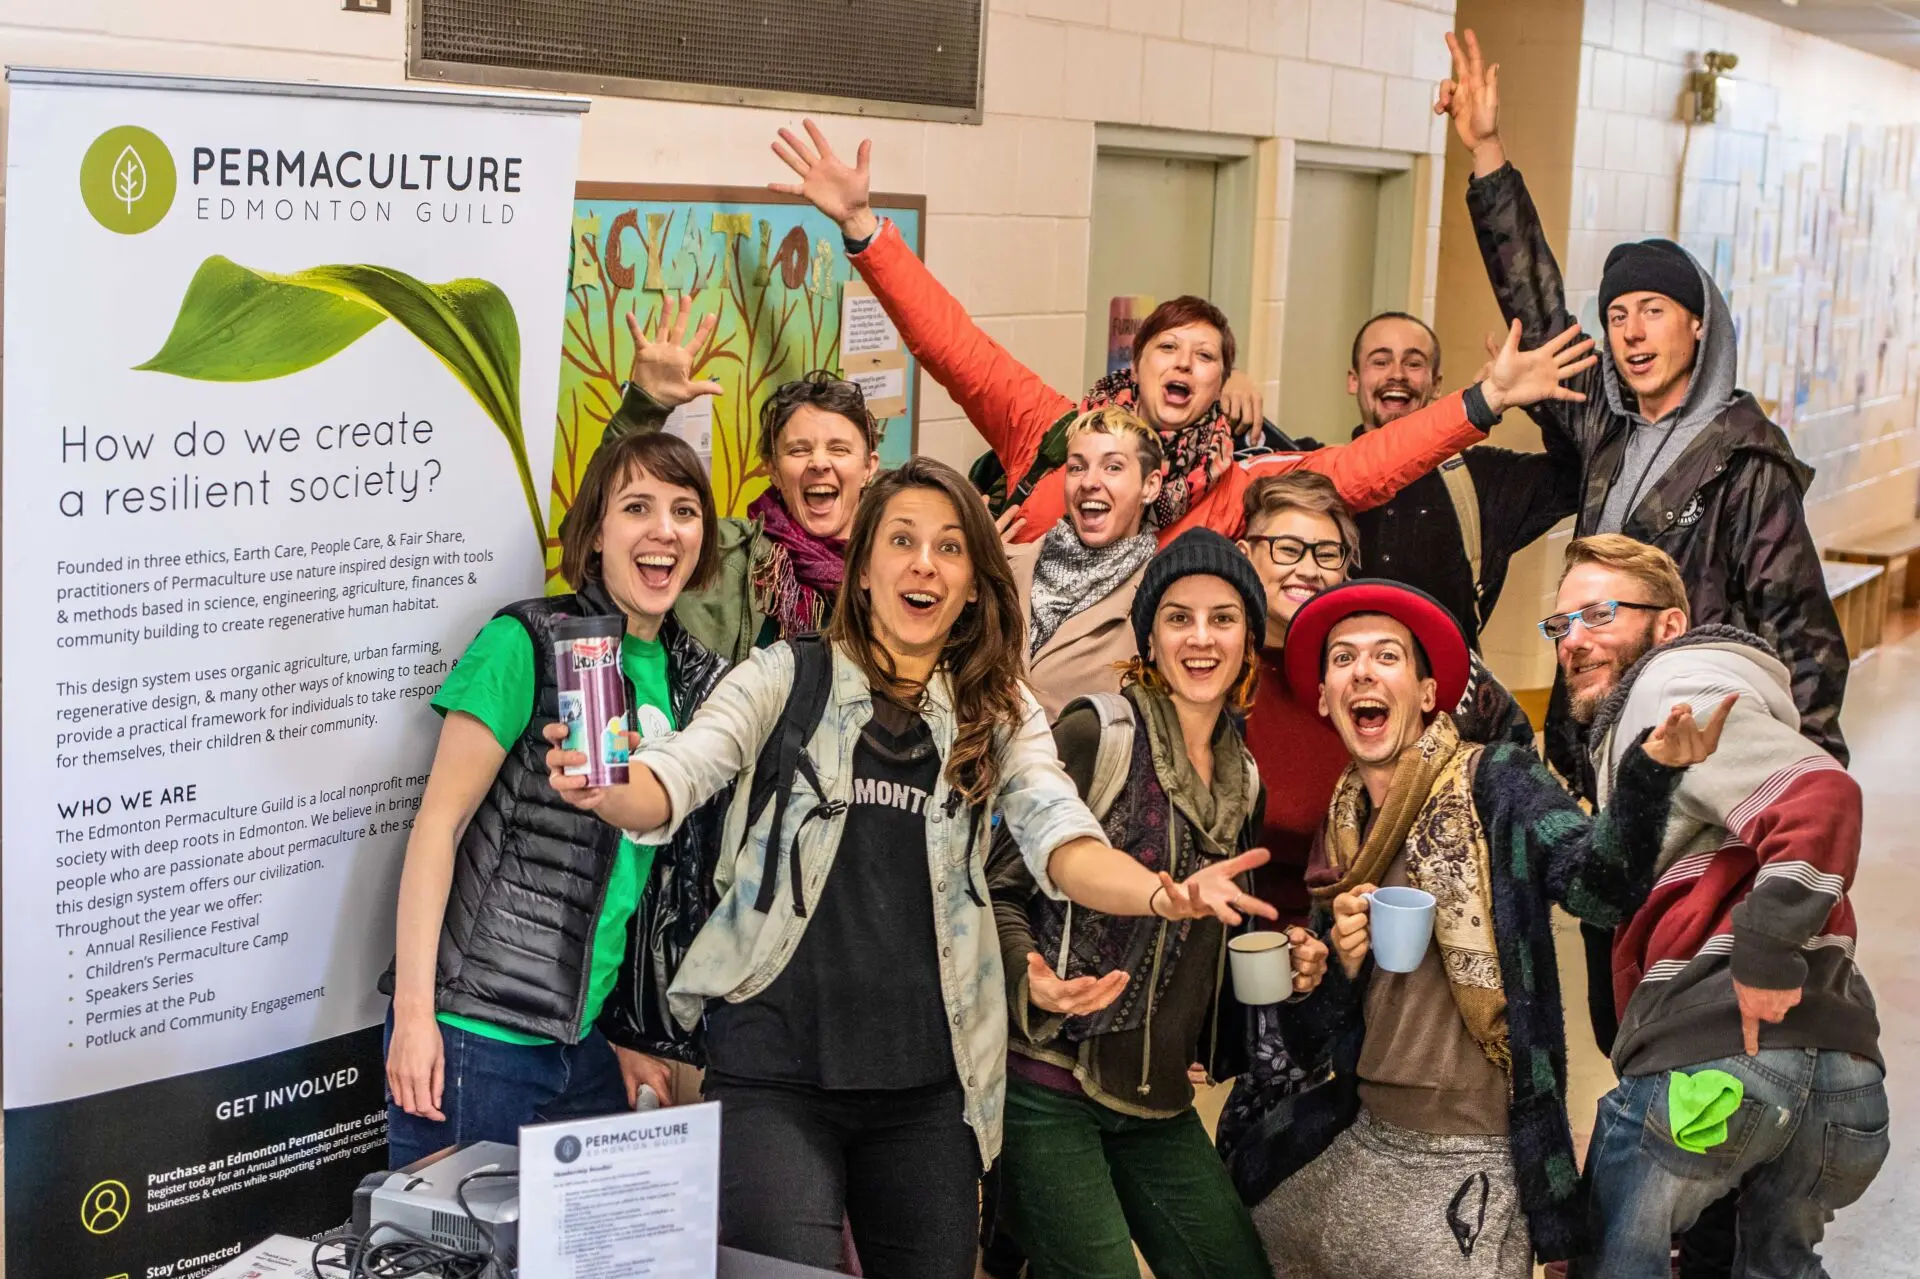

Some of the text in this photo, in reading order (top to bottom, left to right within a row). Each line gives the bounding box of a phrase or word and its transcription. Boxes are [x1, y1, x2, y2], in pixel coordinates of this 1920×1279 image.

[194, 147, 522, 192] PERMACULTURE
[198, 198, 514, 224] EDMONTON GUILD
[63, 412, 433, 463] How do we create
[60, 459, 441, 517] a resilient society?
[58, 530, 465, 575] Founded in three ethics, Earth Care, People Care, Fair Share,
[58, 549, 493, 603] practitioners of Permaculture use nature inspired design with tools
[57, 598, 438, 648] community building to create regenerative human habitat.
[74, 576, 464, 622] methods based in science, engineering, agriculture, finances
[56, 641, 442, 696] This design system uses organic agriculture, urban farming,
[57, 660, 447, 723] regenerative design, many other ways of knowing to teach
[56, 714, 378, 768] for themselves, their children their community.
[57, 726, 112, 748] provide
[130, 715, 186, 740] practical
[192, 707, 266, 728] framework
[270, 705, 288, 719] for
[292, 694, 354, 716] individuals
[356, 694, 368, 704] to
[372, 688, 396, 702] take
[56, 776, 402, 844] The Edmonton Permaculture Guild is local nonprofit
[58, 784, 196, 819] WHO WE ARE
[56, 851, 107, 868] society
[111, 842, 140, 860] with
[144, 840, 178, 854] deep
[183, 833, 218, 848] roots
[224, 830, 234, 842] in
[240, 820, 307, 840] Edmonton.
[310, 813, 329, 826] We
[332, 806, 372, 822] believe
[375, 802, 385, 813] in
[57, 872, 106, 895] people
[110, 868, 139, 883] who
[144, 864, 166, 877] are
[170, 852, 244, 875] passionate
[248, 844, 285, 860] about
[288, 828, 366, 857] permaculture
[381, 820, 399, 834] the
[56, 860, 324, 914] this design system offers our civilization.
[56, 893, 262, 938] Throughout the year we offer:
[86, 913, 259, 956] Annual Resilience Festival
[158, 940, 249, 966] Permaculture
[253, 932, 288, 948] Camp
[86, 972, 194, 1005] Speakers Series
[86, 989, 215, 1026] Permies at the Pub
[86, 986, 326, 1048] Potluck and Community Engagement
[216, 1068, 358, 1120] GET INVOLVED
[148, 1164, 206, 1186] Purchase
[209, 1160, 224, 1171] an
[227, 1142, 286, 1166] Edmonton
[289, 1118, 361, 1148] Permaculture
[586, 1123, 688, 1147] PERMACULTURE
[148, 1183, 187, 1199] Register
[189, 1176, 216, 1189] today
[218, 1172, 232, 1182] for
[233, 1168, 245, 1178] an
[246, 1157, 277, 1174] Annual
[280, 1144, 331, 1165] Membership
[333, 1135, 348, 1147] and
[350, 1128, 378, 1142] receive
[148, 1193, 200, 1212] businesses
[212, 1182, 242, 1196] events
[244, 1174, 268, 1187] while
[269, 1160, 315, 1180] supporting
[323, 1149, 352, 1163] worthy
[147, 1264, 174, 1279] Stay
[177, 1242, 241, 1270] Connected
